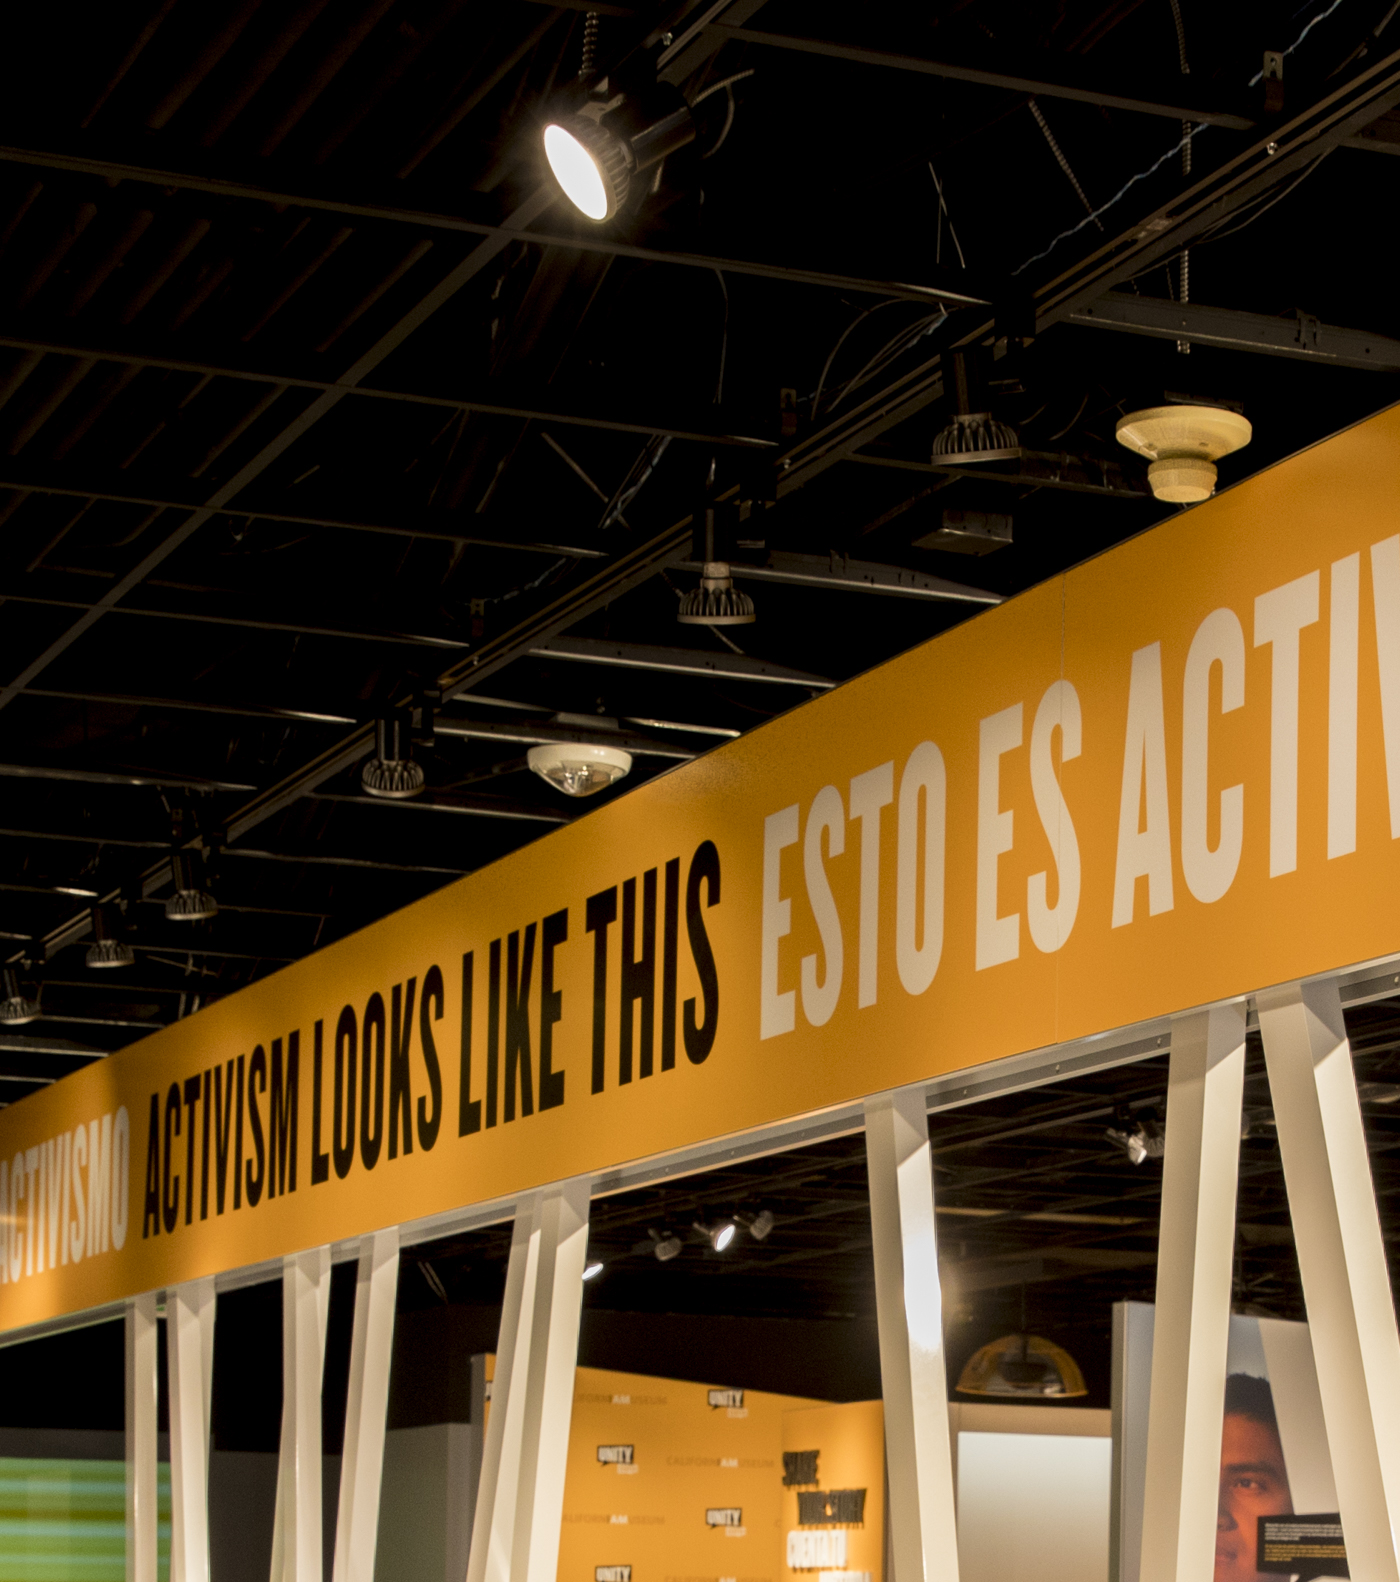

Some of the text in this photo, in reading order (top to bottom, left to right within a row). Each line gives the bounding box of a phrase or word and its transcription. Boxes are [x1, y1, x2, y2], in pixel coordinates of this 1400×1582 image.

[142, 1028, 300, 1240] ACTIVISM
[311, 963, 445, 1186] LOOKS
[459, 906, 570, 1138] LIKE
[585, 838, 722, 1096] THIS
[758, 742, 948, 1041] ESTO
[974, 680, 1083, 972] ES
